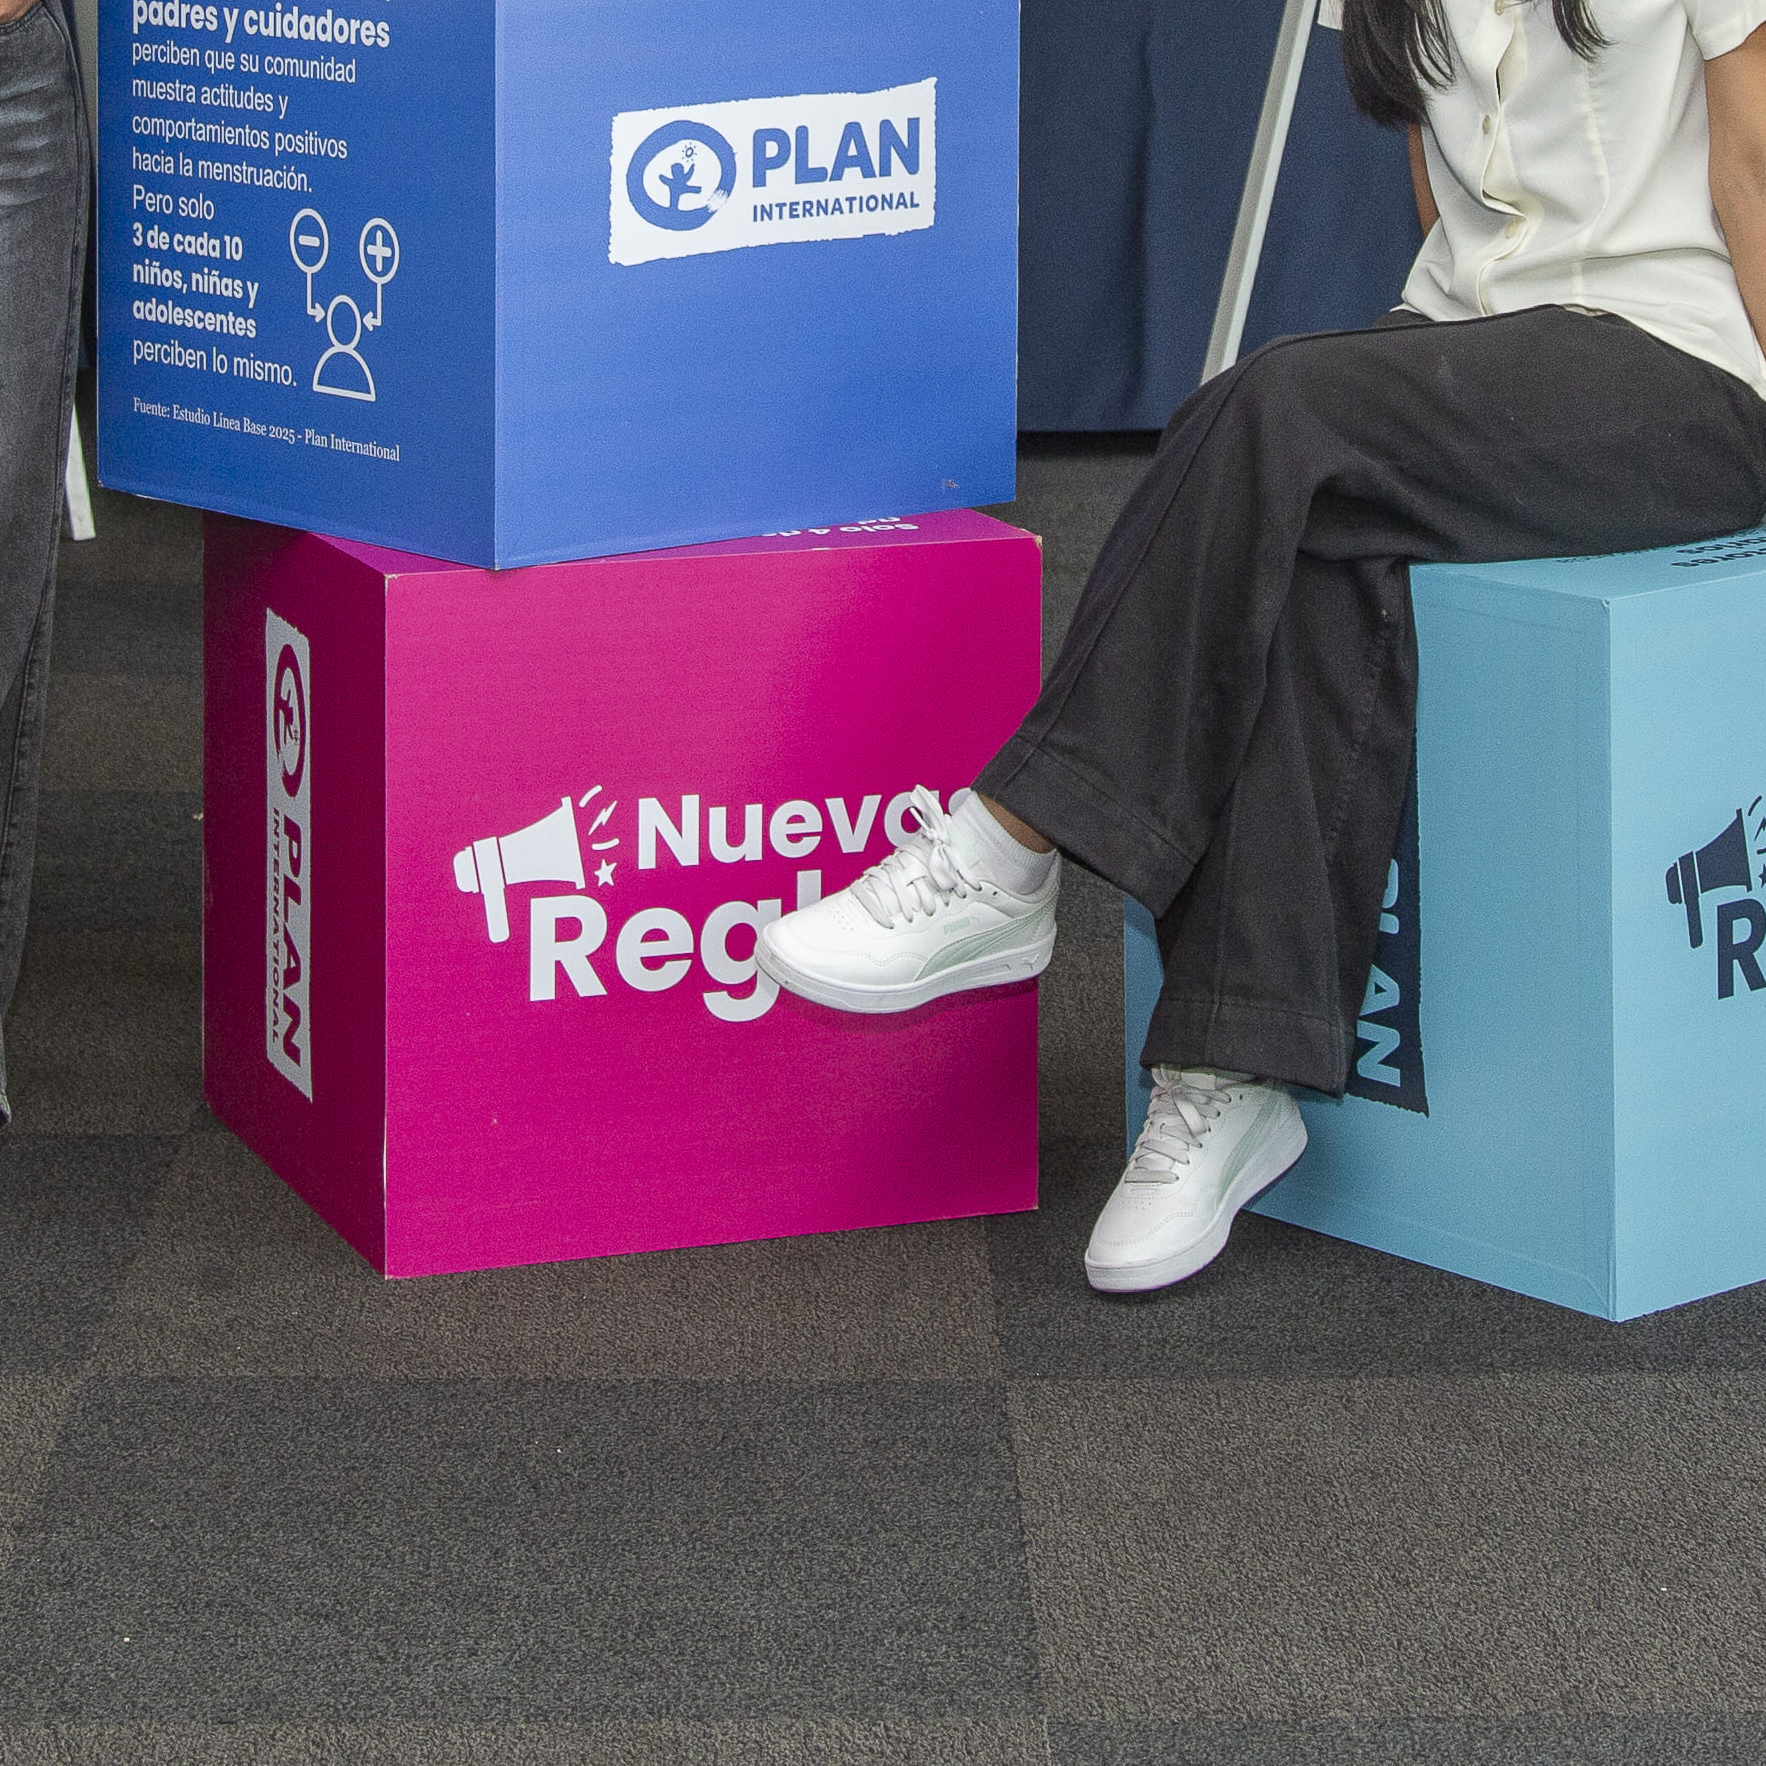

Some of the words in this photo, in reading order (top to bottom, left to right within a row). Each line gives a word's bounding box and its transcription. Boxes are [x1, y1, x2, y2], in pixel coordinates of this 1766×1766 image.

[223, 6, 239, 43] y
[243, 2, 391, 49] cuidadores
[132, 40, 200, 67] perciben
[204, 51, 235, 74] que
[240, 53, 259, 73] su
[264, 54, 356, 83] comunidad
[132, 78, 196, 103] muestra
[201, 83, 274, 112] actitudes
[279, 94, 288, 119] y
[132, 115, 270, 150] comportamientos
[274, 129, 348, 159] positivos
[752, 116, 921, 189] PLAN
[132, 146, 174, 175] hacia
[179, 152, 193, 177] la
[198, 158, 313, 193] menstruación.
[132, 184, 173, 215] Pero
[178, 192, 215, 220] solo
[752, 191, 921, 223] INTERNATIONAL
[133, 222, 143, 246] 3
[147, 225, 170, 250] de
[173, 232, 220, 258] cada
[224, 235, 243, 261] 10
[133, 258, 187, 294] niños,
[191, 267, 243, 299] niñas
[247, 280, 259, 309] y
[133, 297, 257, 338] adolescentes
[133, 338, 207, 371] perciben
[212, 346, 228, 374] lo
[234, 353, 297, 387] mismo.
[133, 397, 170, 418] Fuente:
[173, 404, 211, 426] Estudio
[213, 411, 241, 431] Línea
[243, 417, 267, 436] Base
[269, 425, 296, 445] 2025
[305, 428, 328, 448] Plan
[330, 433, 401, 462] International
[638, 787, 976, 870] Nueva
[272, 807, 282, 1045] INTERNATIONAL
[282, 813, 302, 1068] PLAN
